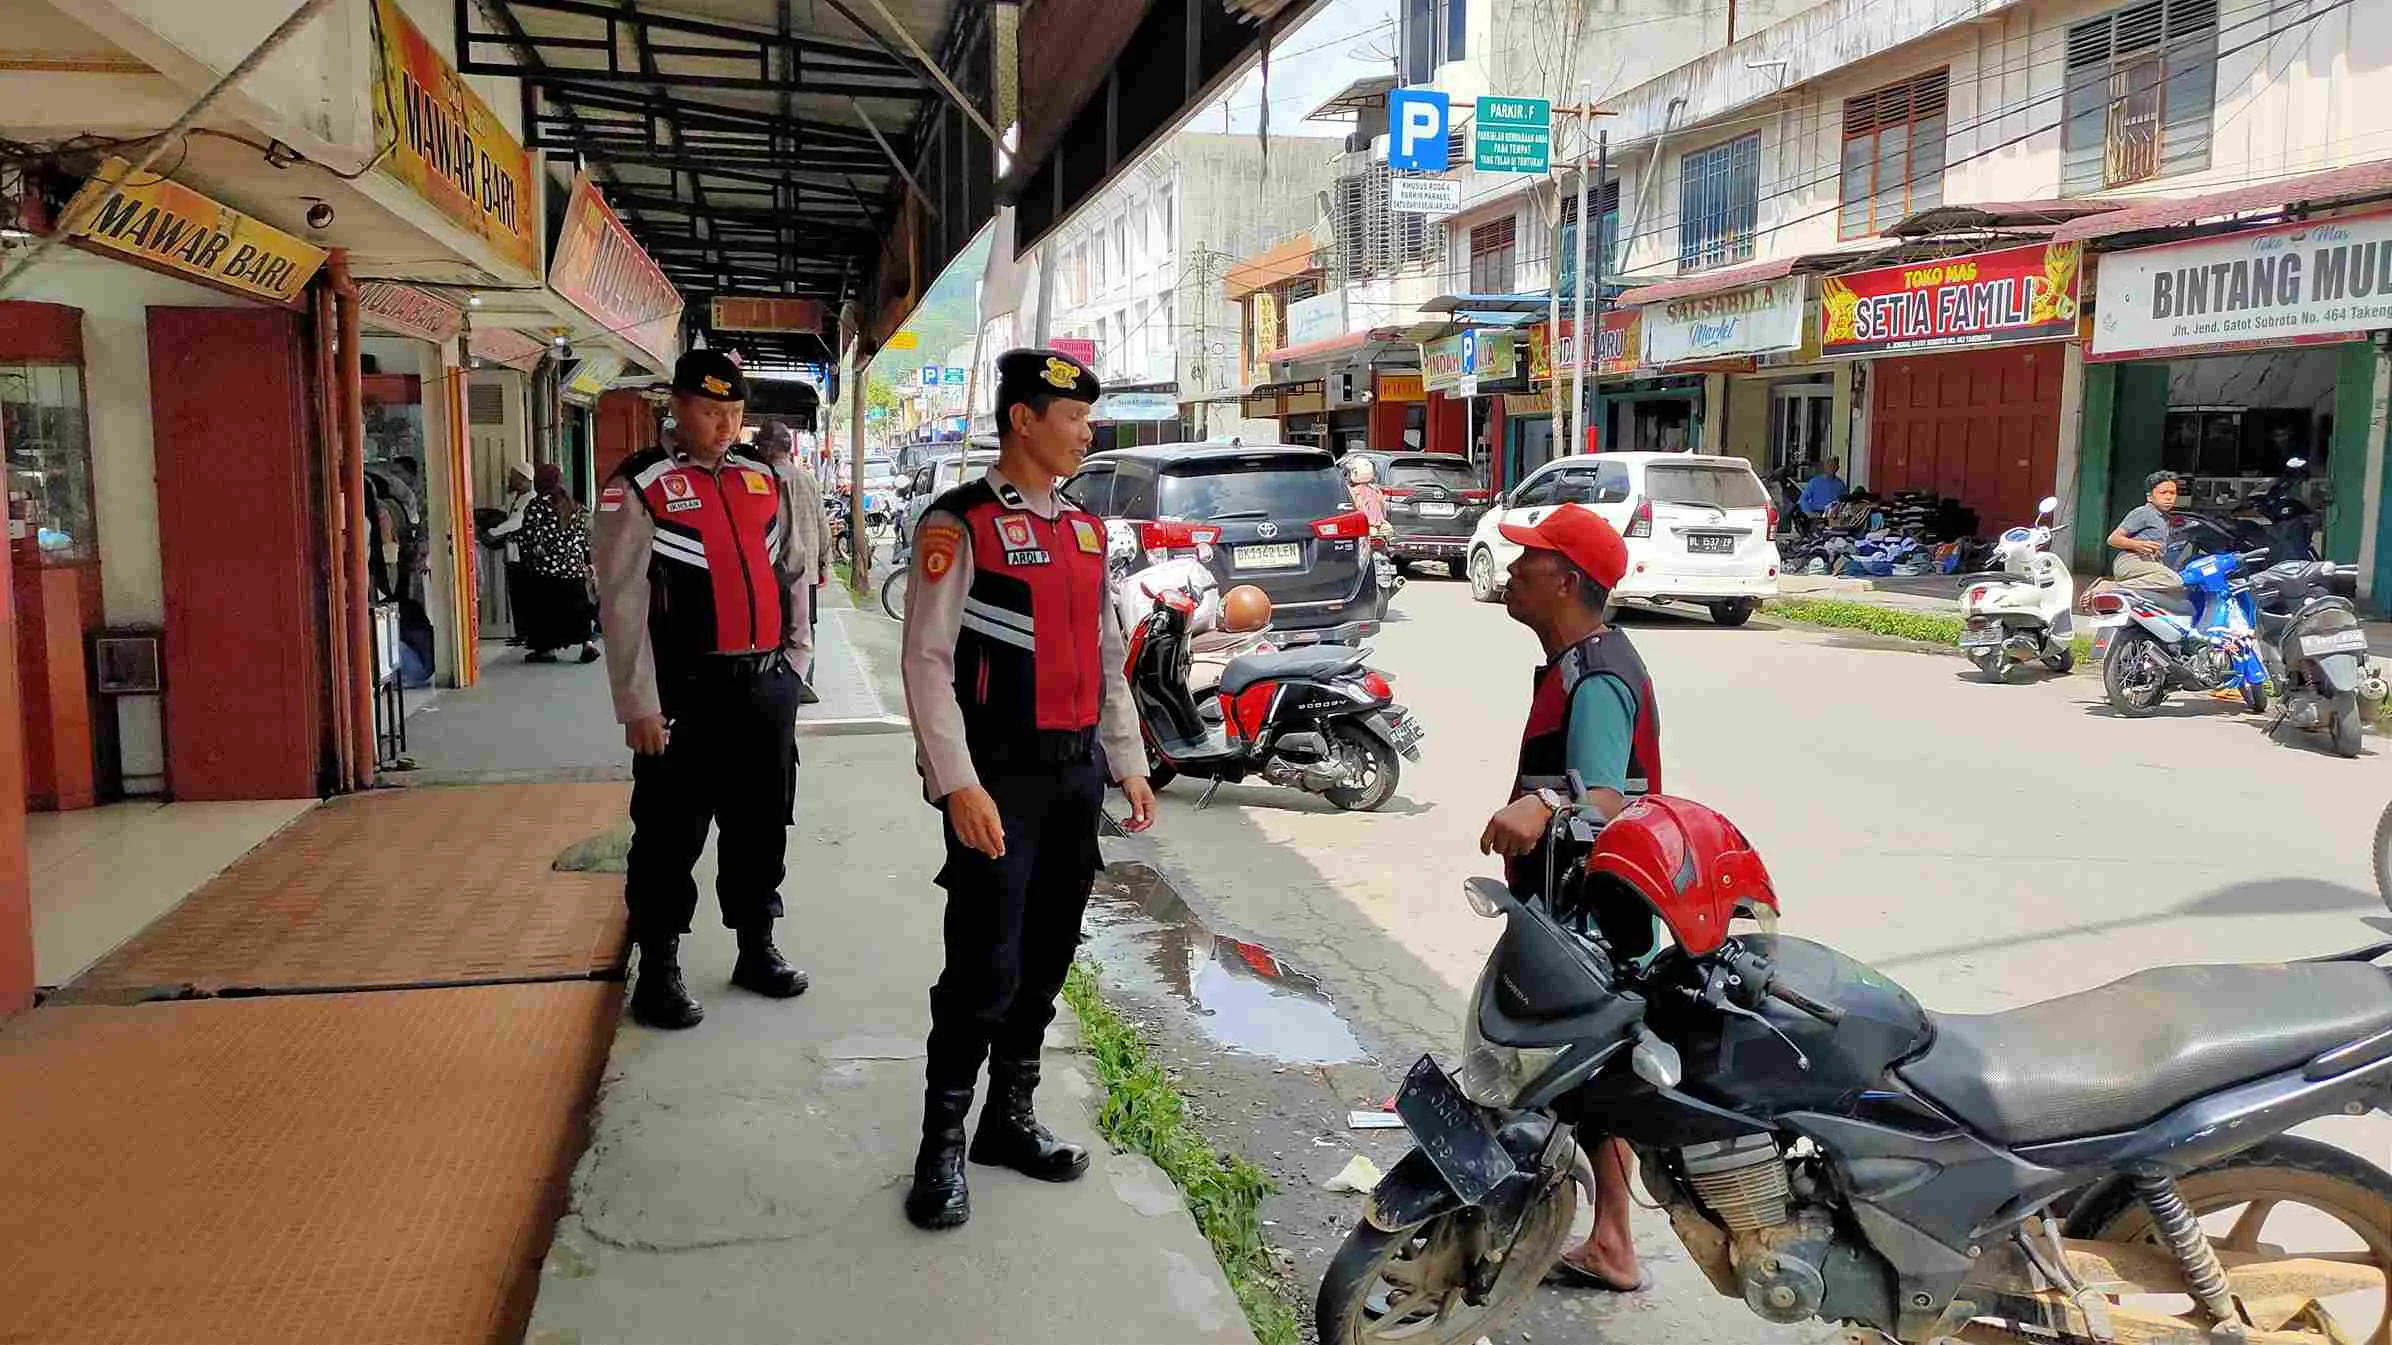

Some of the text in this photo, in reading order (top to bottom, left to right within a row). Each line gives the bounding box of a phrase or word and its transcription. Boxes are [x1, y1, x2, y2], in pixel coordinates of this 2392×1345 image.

[402, 67, 477, 202] MAWAR
[481, 148, 520, 237] BARU
[1402, 101, 1439, 156] P
[88, 192, 298, 293] MAWAR BARU
[1904, 261, 1977, 289] TOKO MAS
[1856, 275, 2034, 340] SETIA FAMILI
[2152, 251, 2301, 320] BINTANG
[2223, 319, 2251, 331] Gatot
[2323, 307, 2346, 321] 464
